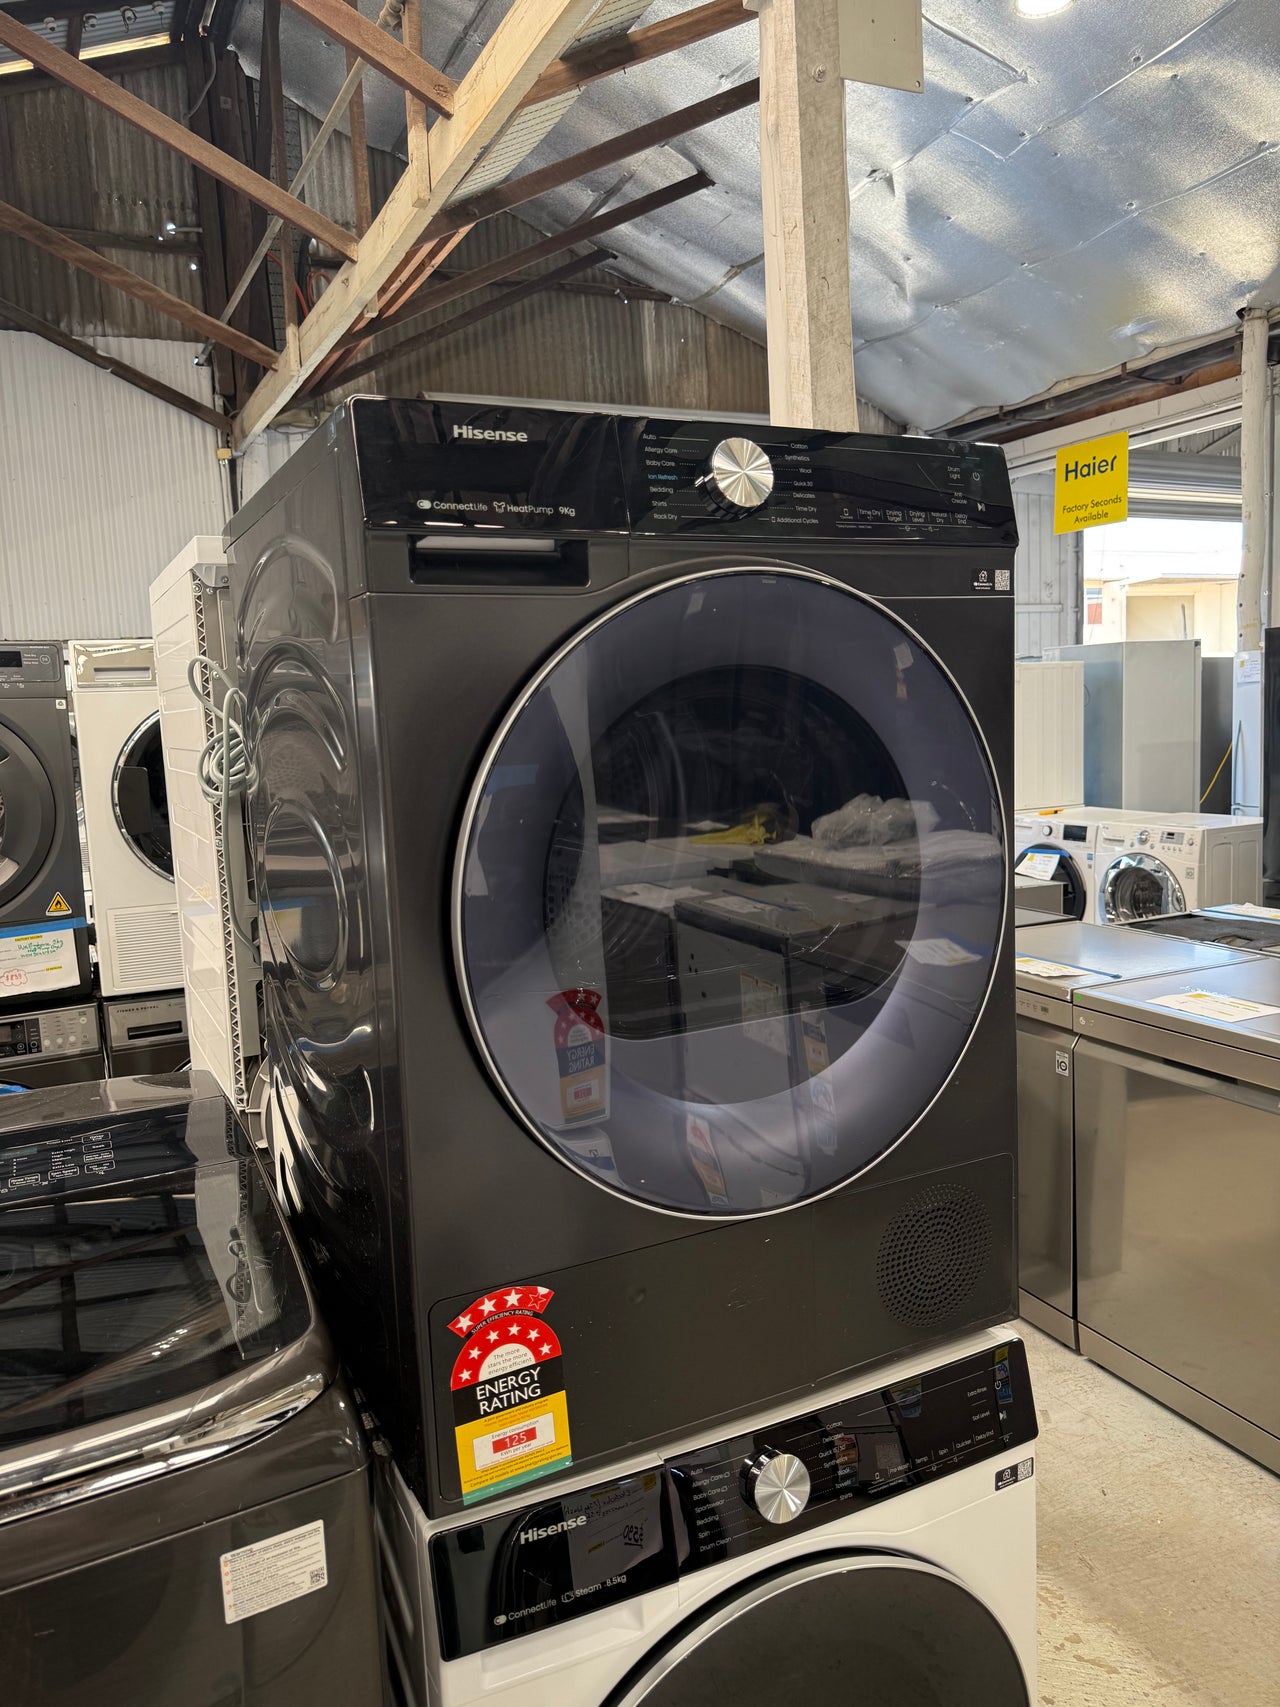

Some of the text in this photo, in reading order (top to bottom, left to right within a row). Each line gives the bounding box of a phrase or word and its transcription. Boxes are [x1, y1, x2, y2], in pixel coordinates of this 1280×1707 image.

[453, 424, 528, 443] Hisense
[642, 433, 657, 441] Auto
[644, 446, 660, 454] Allergy
[646, 459, 659, 467] Baby
[784, 454, 811, 462] Synthetics
[1065, 455, 1117, 482] Haier
[656, 473, 678, 481] Refresh
[649, 486, 674, 494] Bedding
[433, 500, 576, 517] ConnectLife HeatPump 9Kg
[1062, 494, 1122, 514] Factory Seconds
[776, 516, 819, 525] Additional Cycles
[909, 510, 926, 518] Drying
[1073, 509, 1109, 524] Available
[471, 1320, 487, 1334] SUPER
[486, 1310, 515, 1323] EFFICIENCY
[504, 1348, 520, 1356] more
[487, 1361, 502, 1369] stars
[512, 1352, 528, 1360] more
[488, 1357, 532, 1375] energy efficient
[476, 1366, 541, 1400] ENERGY
[480, 1383, 541, 1415] RATING
[491, 1420, 540, 1439] Energy consumption
[825, 1421, 843, 1430] Cotton
[504, 1431, 527, 1448] 125
[822, 1432, 845, 1443] Delicates
[512, 1446, 521, 1454] per
[521, 1443, 532, 1451] year
[818, 1449, 833, 1458] Quick
[823, 1456, 848, 1469] Synthetics
[914, 1455, 929, 1464] Temp
[692, 1474, 724, 1488] Allergy Care
[693, 1487, 722, 1501] Baby Care
[694, 1499, 725, 1514] Sportswear
[696, 1514, 720, 1526] Bedding
[520, 1514, 588, 1545] Hisense
[698, 1530, 711, 1539] Spin
[699, 1536, 732, 1552] Drum Clean
[575, 1574, 627, 1598] Steam 8.5kg
[508, 1598, 557, 1621] ConnectLife
